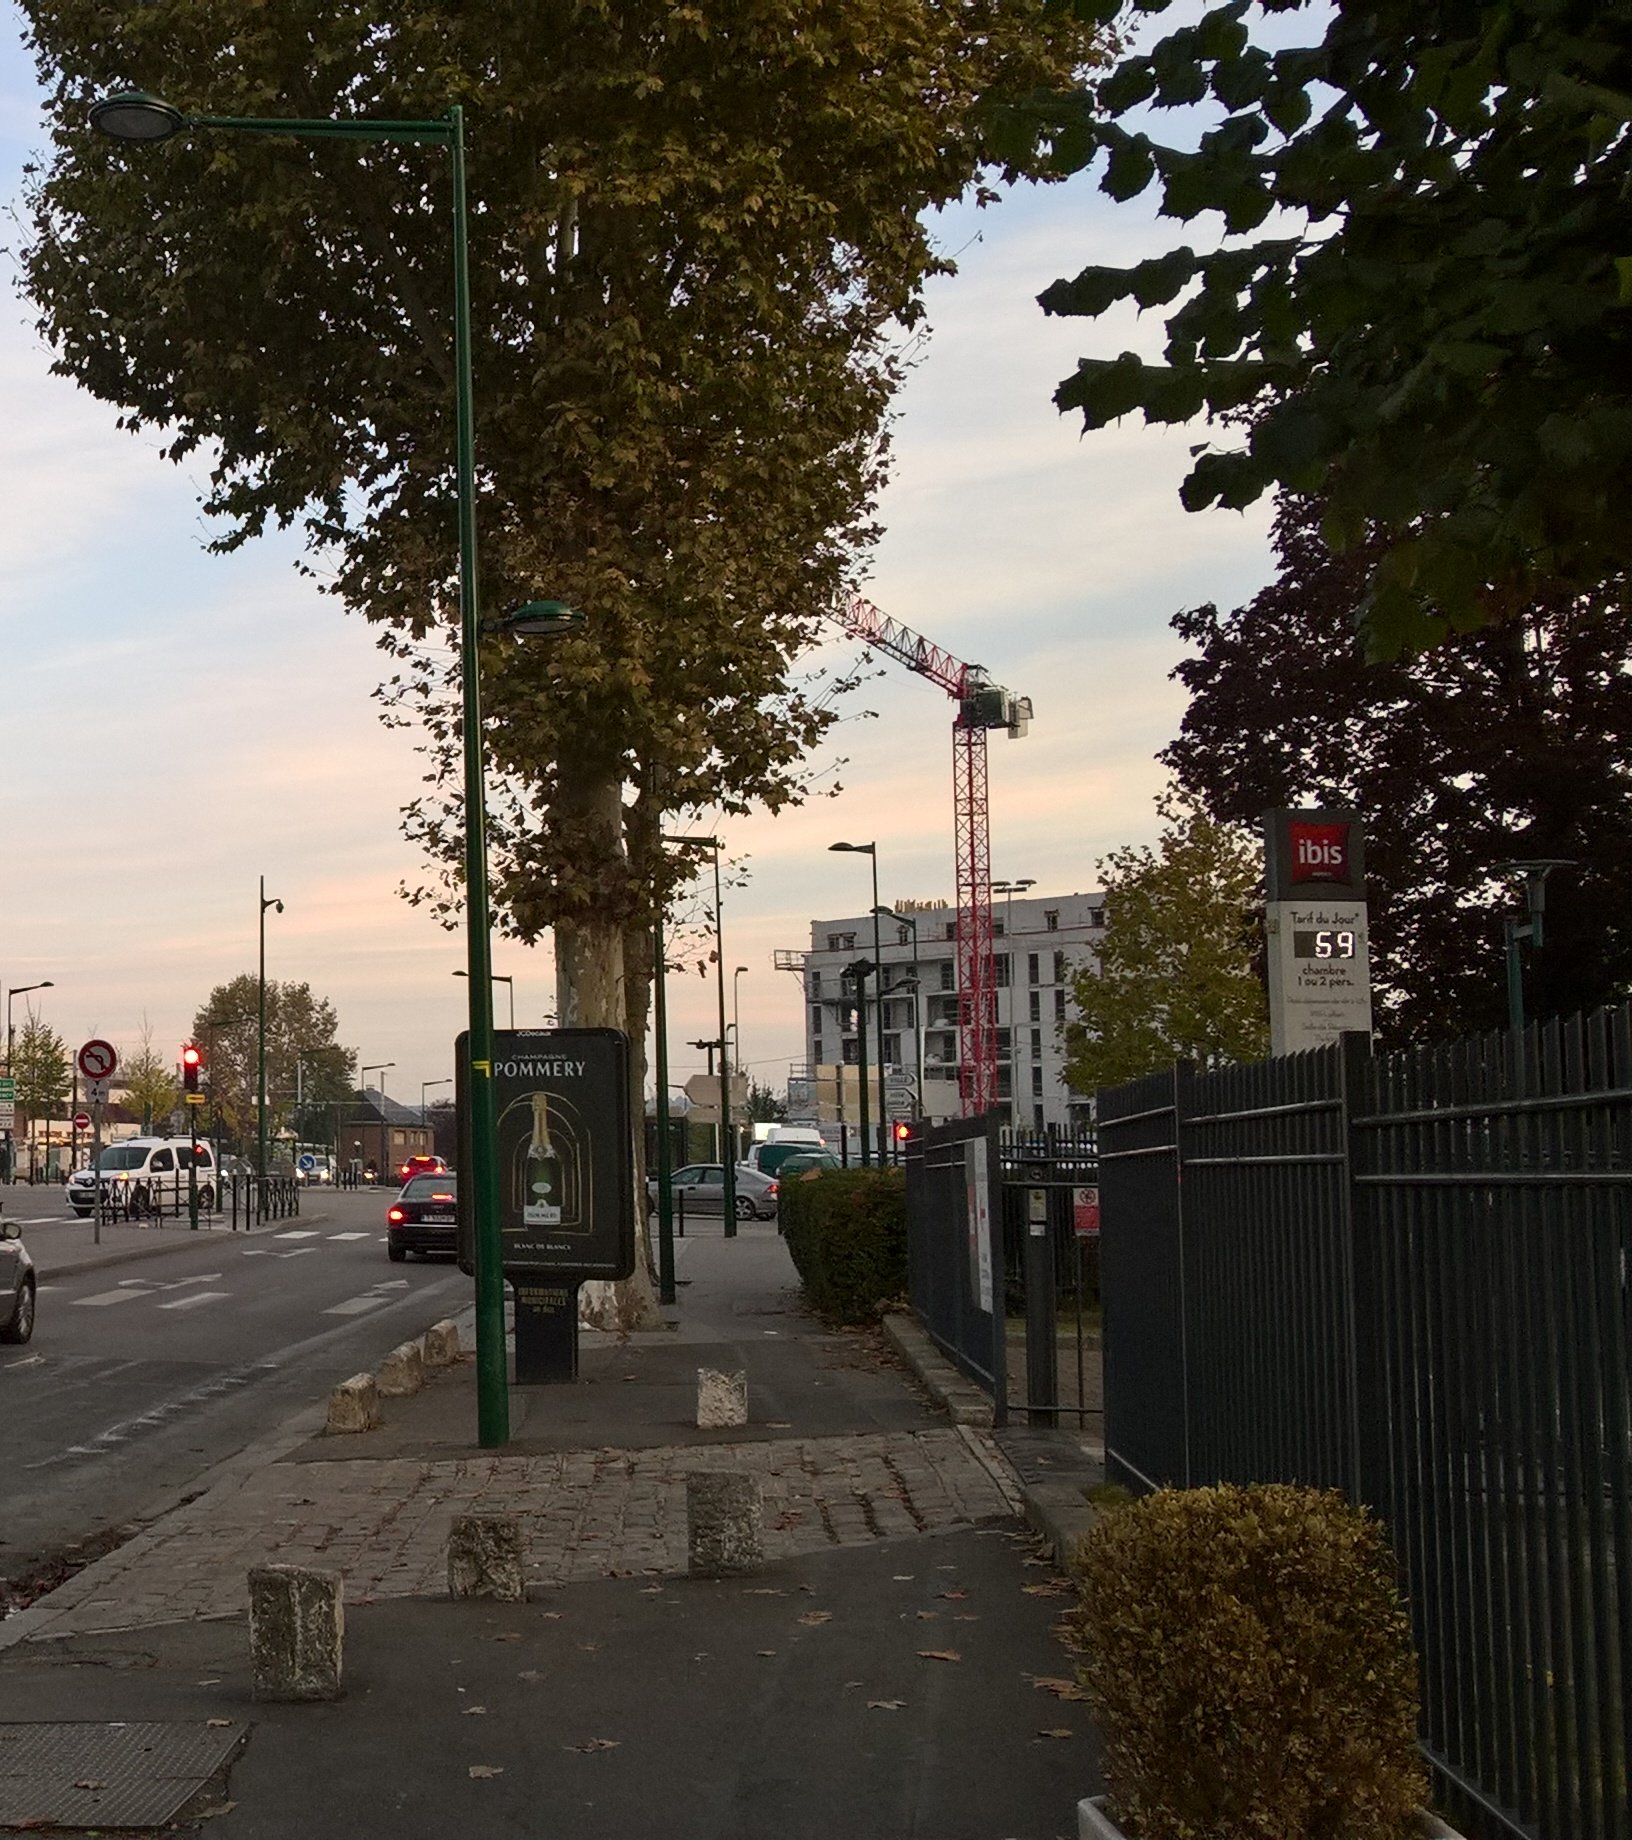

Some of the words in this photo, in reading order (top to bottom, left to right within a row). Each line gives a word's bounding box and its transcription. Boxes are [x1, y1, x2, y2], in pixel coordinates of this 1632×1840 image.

[1298, 839, 1343, 865] ibis
[1290, 911, 1314, 924] Tarif
[1316, 911, 1329, 924] du
[1315, 931, 1353, 958] 59
[1302, 962, 1346, 976] chambre
[1304, 978, 1317, 986] ou
[1319, 975, 1326, 986] 2
[1329, 978, 1354, 989] pers.
[494, 1061, 586, 1077] POMMERY
